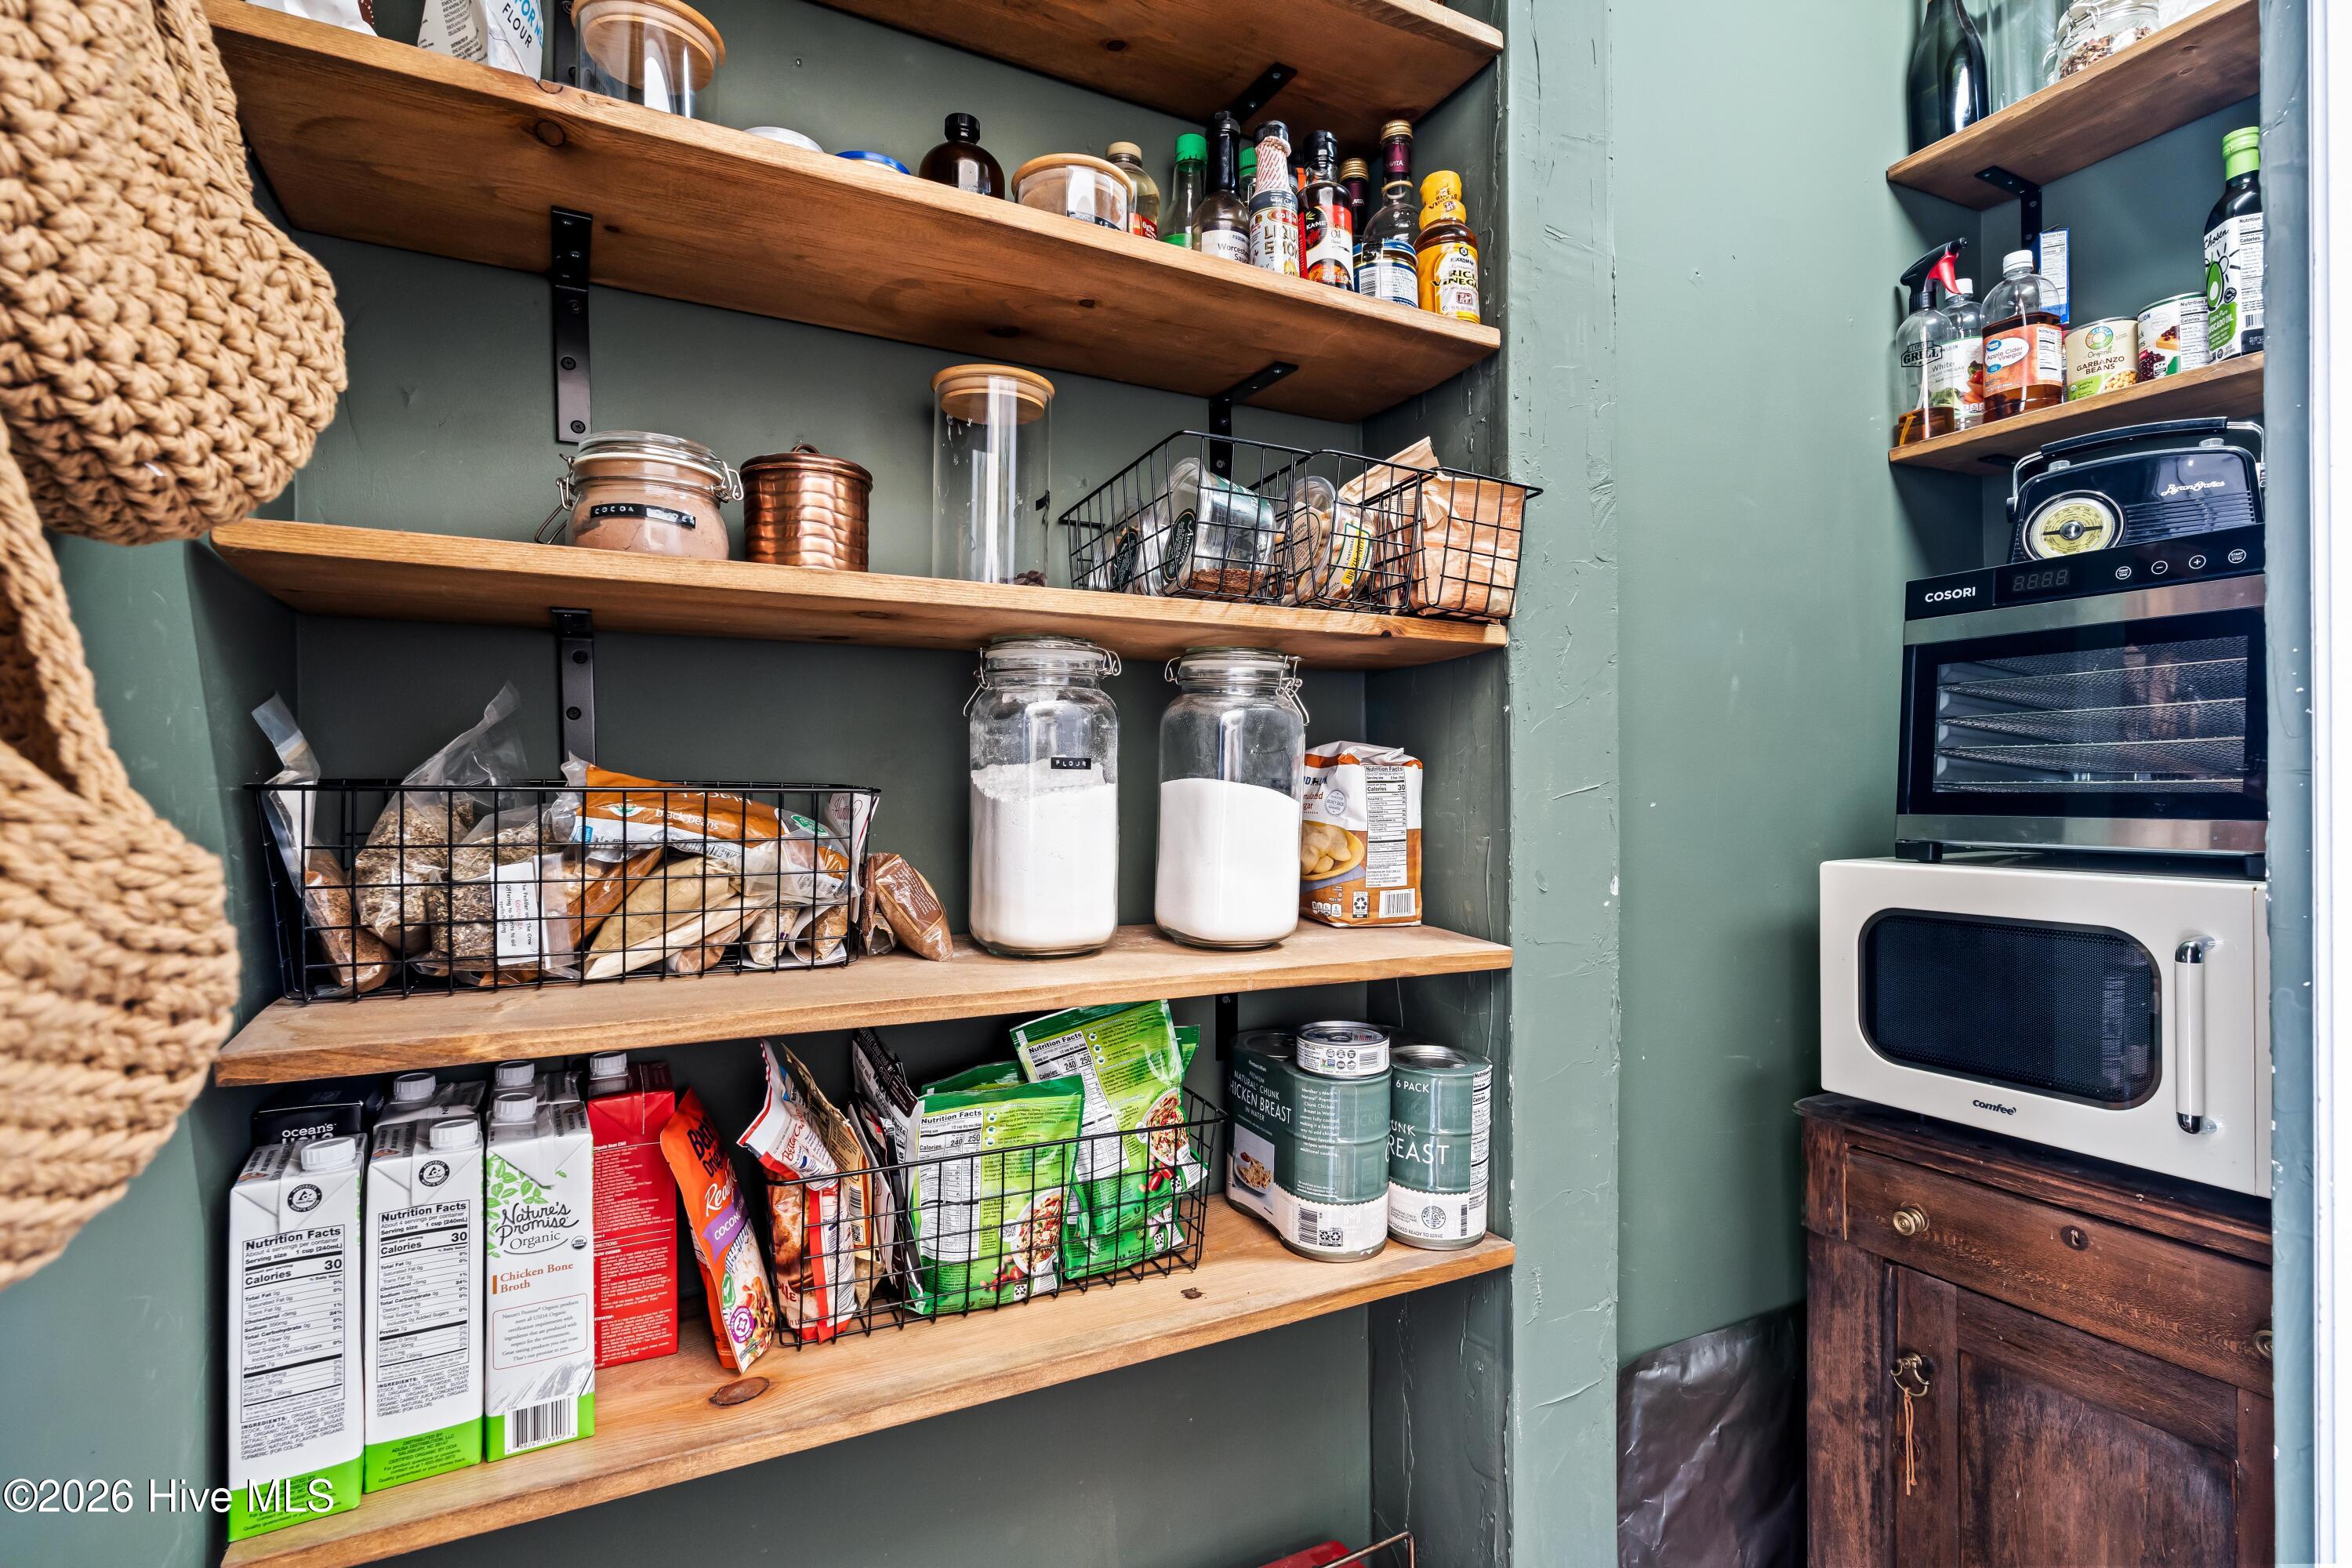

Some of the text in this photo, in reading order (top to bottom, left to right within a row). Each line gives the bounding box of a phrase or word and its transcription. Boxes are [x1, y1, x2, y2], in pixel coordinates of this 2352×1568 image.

[502, 3, 532, 49] FLOUR
[1330, 229, 1341, 238] Oil
[1987, 346, 2023, 360] Apple Cider
[1998, 351, 2023, 361] Vinegar
[2087, 349, 2112, 358] Organic
[1932, 361, 1953, 373] White
[2076, 356, 2125, 372] GARBANZO
[2085, 363, 2115, 375] BEANS
[594, 506, 634, 515] COCOA
[1925, 586, 1976, 603] COSORI
[1029, 1032, 1082, 1054] Nutrition Facts
[1064, 1055, 1091, 1071] 240 250
[1039, 1069, 1058, 1080] Calories
[1260, 1086, 1279, 1100] CHUNK
[1396, 1080, 1430, 1093] 6 PACK
[1251, 1110, 1265, 1121] WATER
[1260, 1097, 1291, 1123] BREAST
[921, 1113, 956, 1125] Nutrition
[281, 1123, 334, 1138] ocean's
[968, 1134, 980, 1142] 250
[292, 1184, 318, 1193] PROTECTS
[381, 1203, 466, 1221] Nutrition Facts
[502, 1202, 571, 1225] Nature's
[495, 1217, 579, 1246] Promise
[246, 1229, 341, 1250] Nutrition Facts
[381, 1232, 467, 1254] Calories 30
[510, 1231, 561, 1249] Organic
[245, 1256, 271, 1265] Serving
[316, 1243, 343, 1252] (240mL)
[245, 1258, 342, 1285] Calories 30
[500, 1262, 574, 1282] Chicken Bone
[380, 1282, 411, 1291] Cholesterol
[500, 1279, 530, 1293] Broth
[395, 1293, 431, 1302] Carbohydrate
